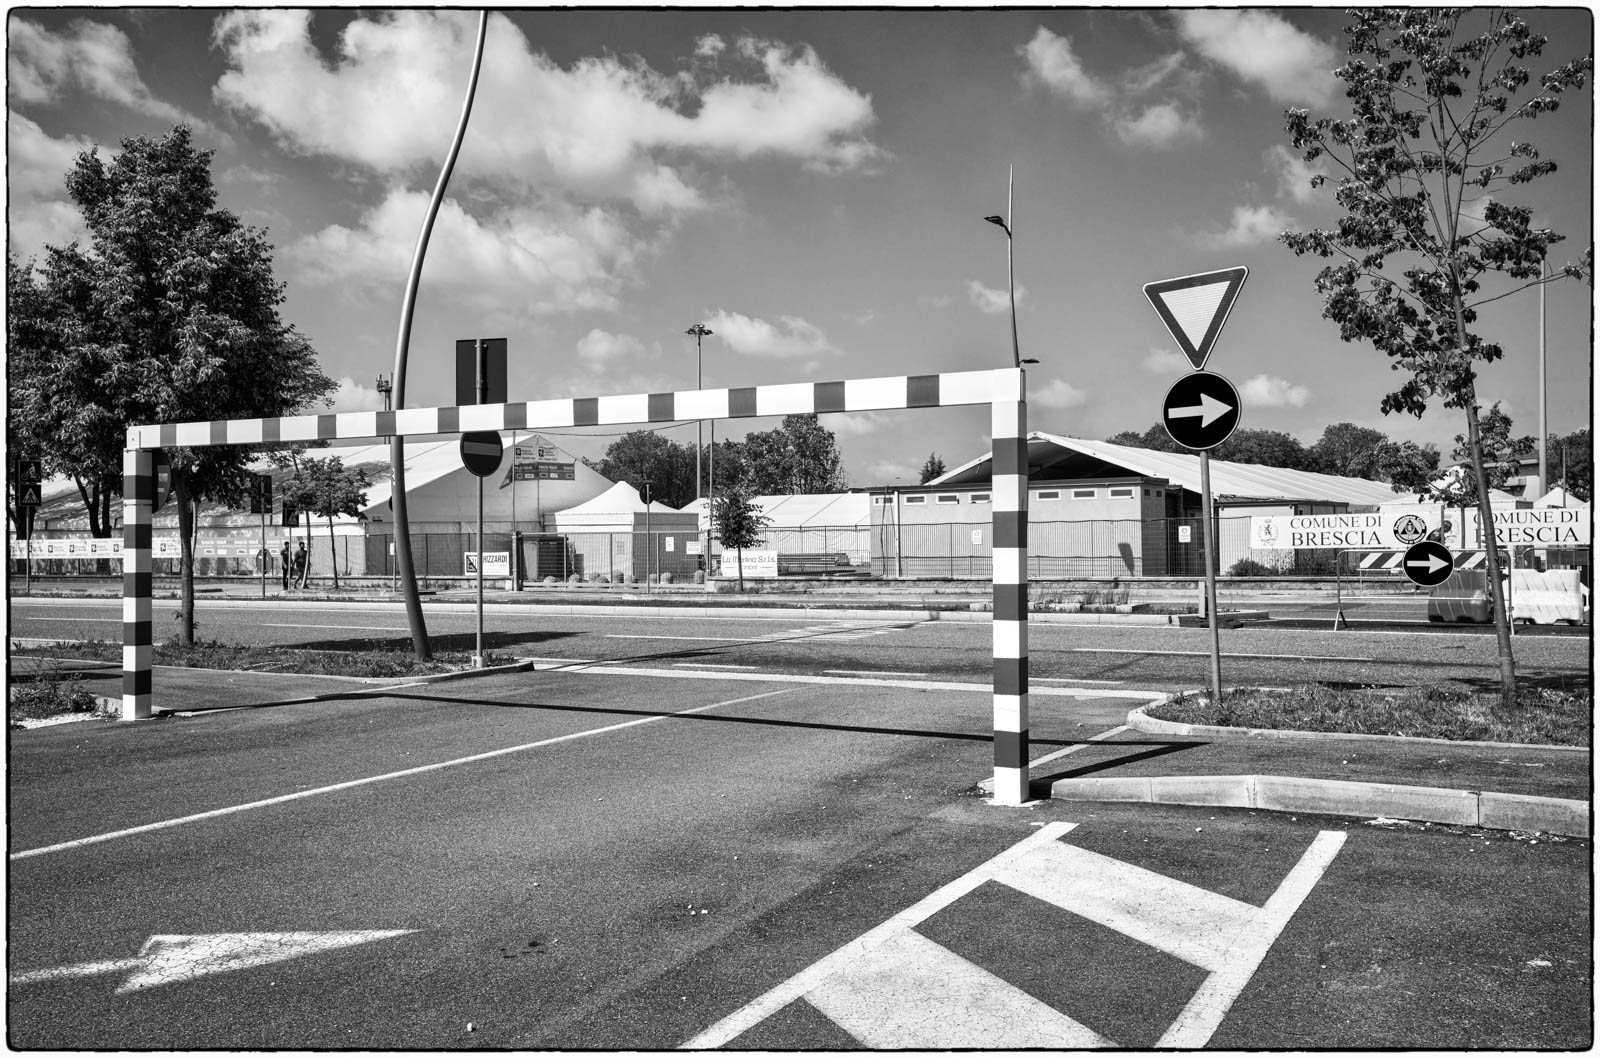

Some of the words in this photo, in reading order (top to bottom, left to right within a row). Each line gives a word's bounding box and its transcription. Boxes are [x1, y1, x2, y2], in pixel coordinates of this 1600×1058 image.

[1290, 516, 1360, 529] COMUNE
[1365, 515, 1382, 527] DI
[1560, 510, 1580, 523] DI
[1291, 530, 1382, 546] BRESCIA
